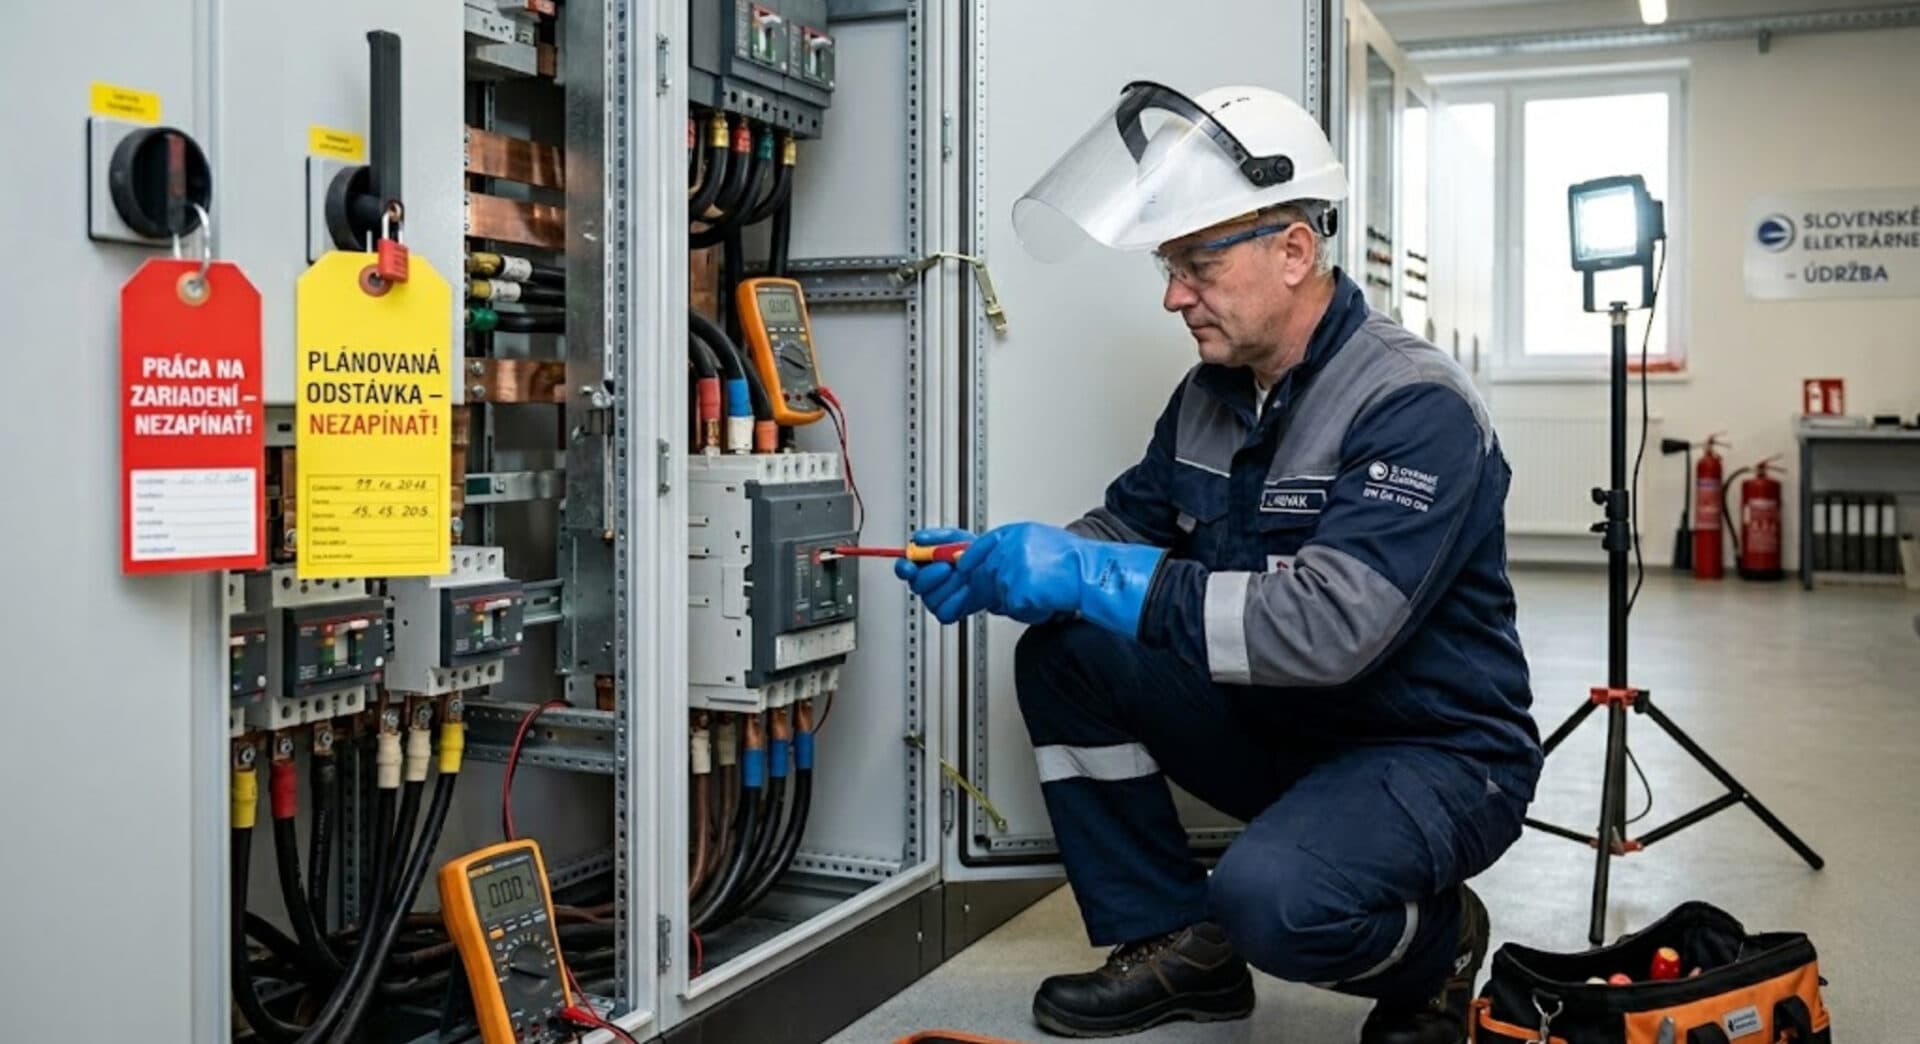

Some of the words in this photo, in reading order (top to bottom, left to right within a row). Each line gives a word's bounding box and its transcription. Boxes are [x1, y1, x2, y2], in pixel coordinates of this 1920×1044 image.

[1803, 204, 1920, 229] SLOVENSKÉ
[1803, 230, 1920, 250] ELEKTRÁRNE
[1804, 259, 1889, 283] ÚDRŽBA
[142, 353, 212, 379] PRÁCA
[216, 358, 245, 379] NA
[308, 345, 441, 374] PLÁNOVANÁ
[130, 383, 239, 407] ZARIADENÍ
[306, 378, 423, 404] ODSTÁVKA
[134, 409, 253, 435] NEZAPÍNAŤ!
[309, 409, 439, 436] NEZAPÍNAŤ!
